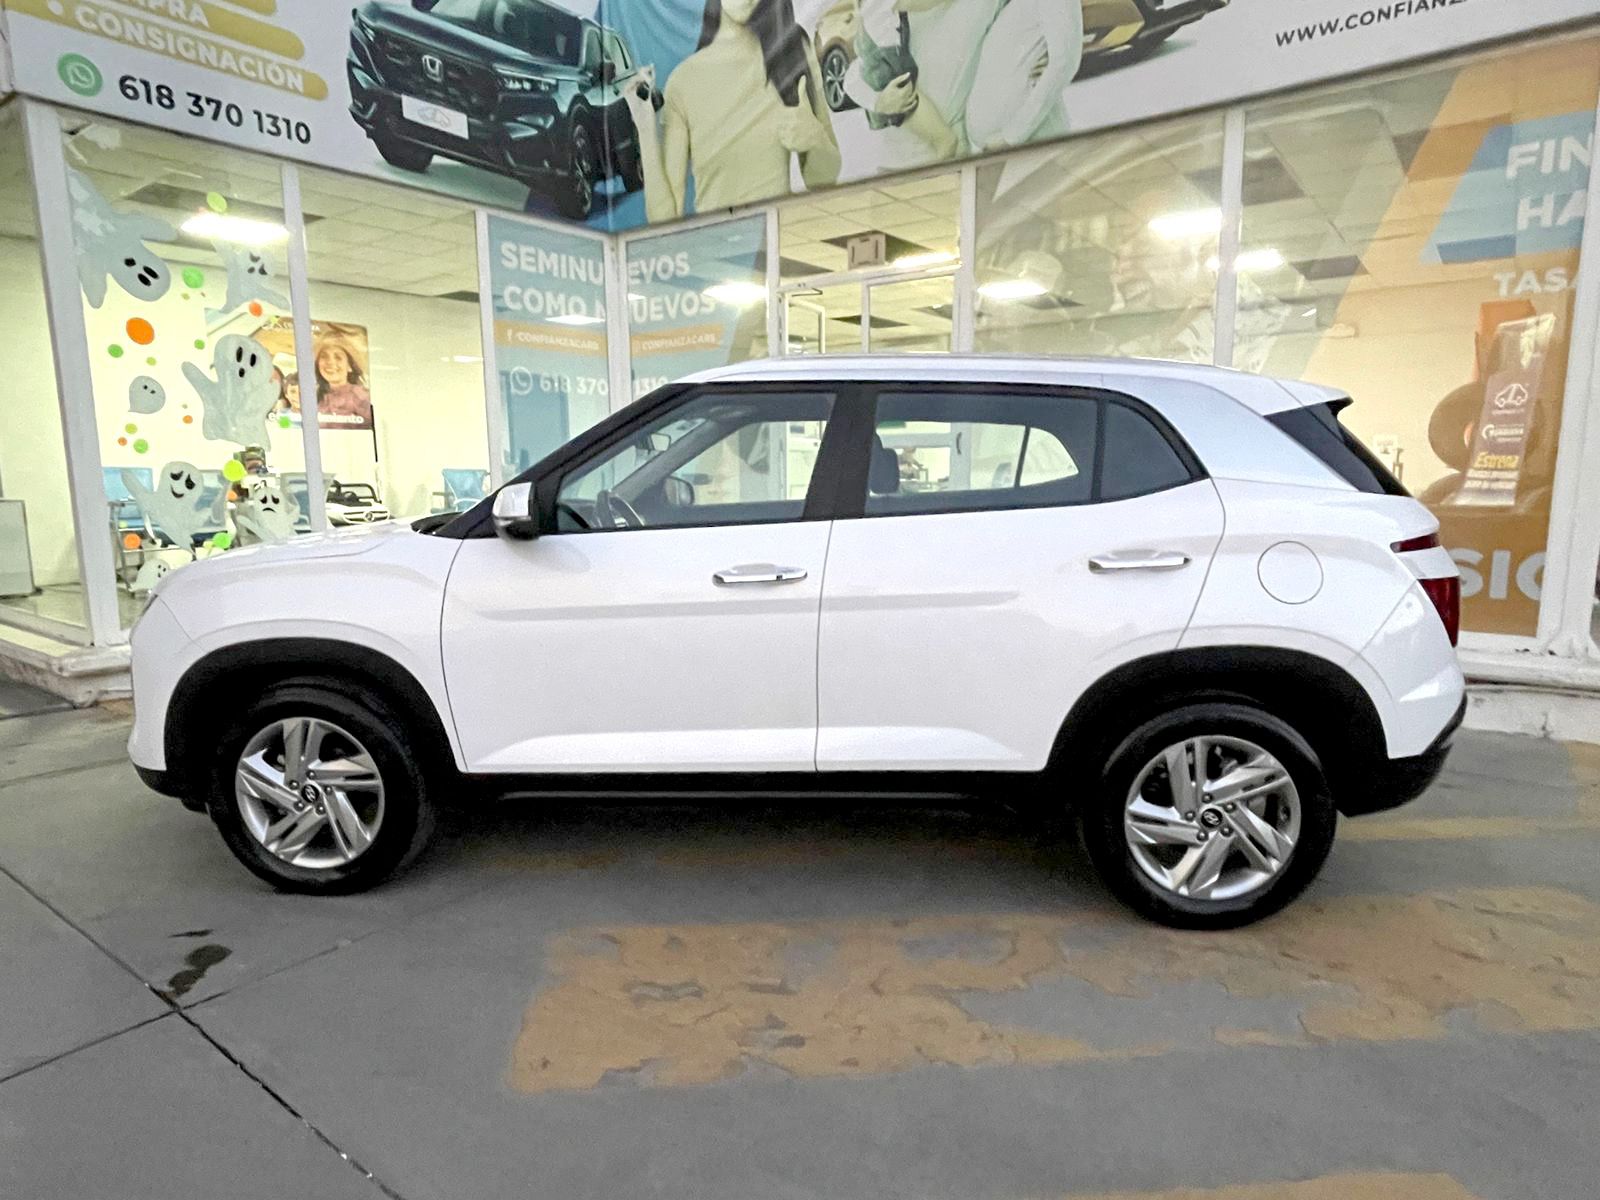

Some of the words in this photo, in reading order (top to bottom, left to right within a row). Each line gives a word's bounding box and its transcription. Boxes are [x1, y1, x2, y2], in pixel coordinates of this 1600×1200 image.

[136, 0, 209, 28] PRA
[1275, 0, 1467, 46] WWW.CONFIAN
[75, 5, 304, 93] CONSIGNACIÓN
[119, 75, 175, 110] 618
[186, 92, 243, 127] 370
[253, 109, 311, 145] 1310
[503, 286, 587, 318] COMO
[540, 372, 571, 394] 618
[576, 376, 609, 396] 370
